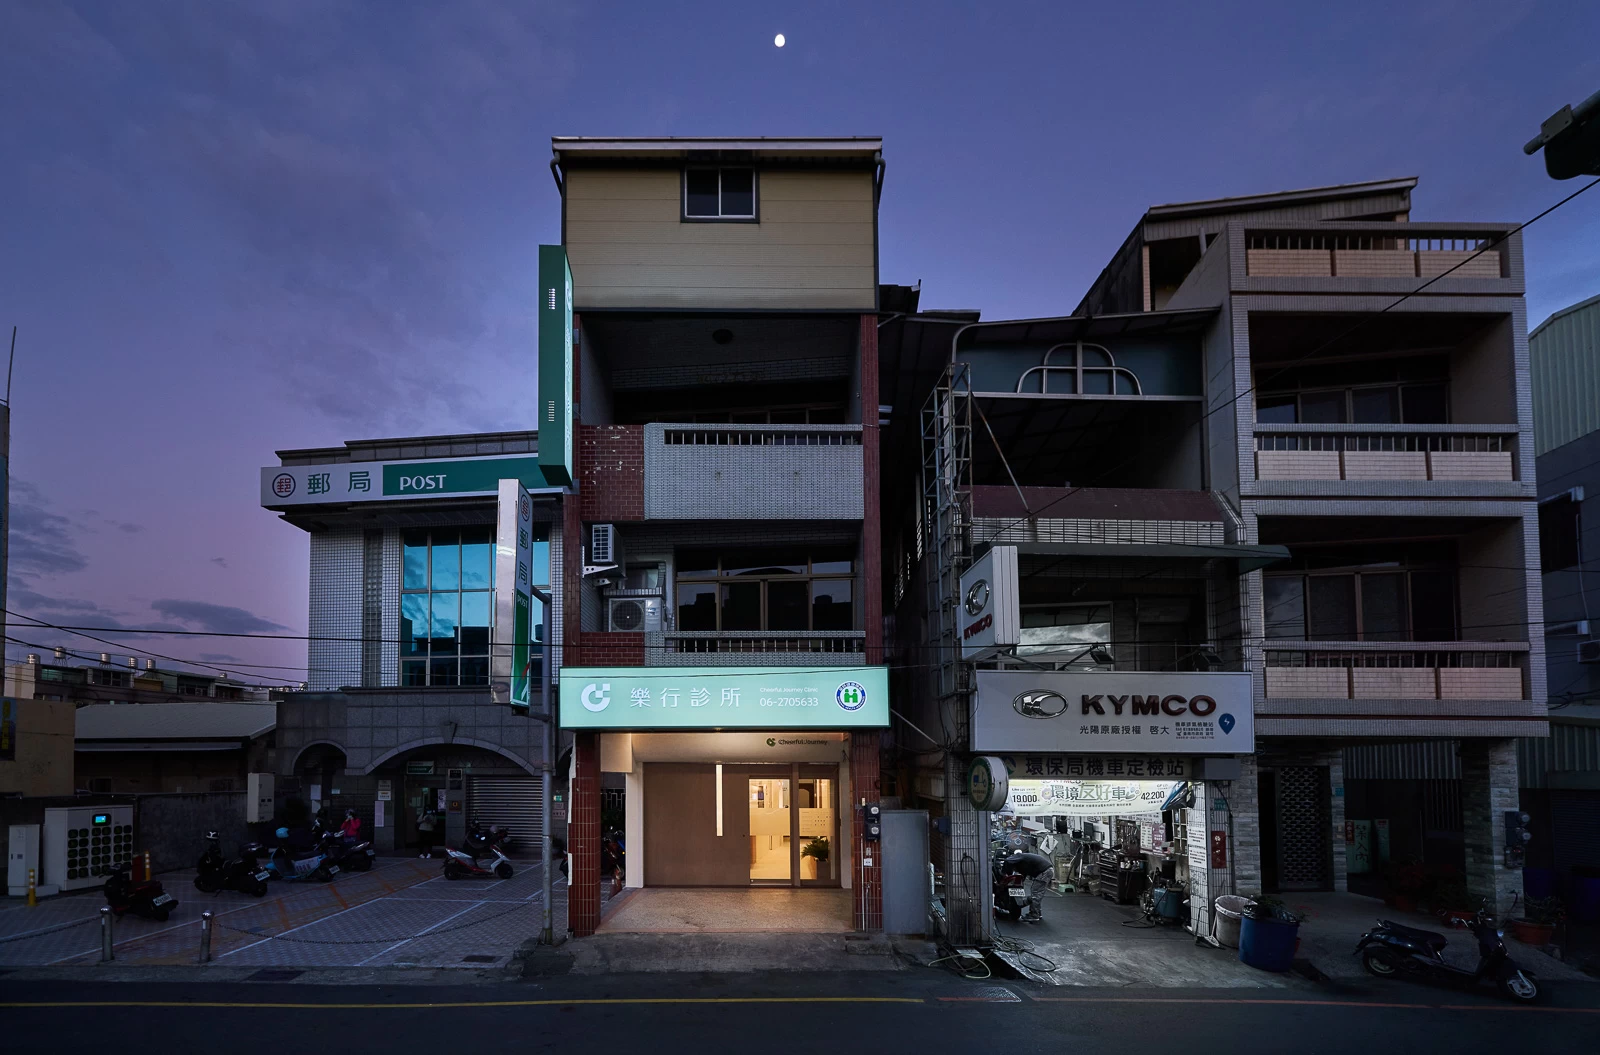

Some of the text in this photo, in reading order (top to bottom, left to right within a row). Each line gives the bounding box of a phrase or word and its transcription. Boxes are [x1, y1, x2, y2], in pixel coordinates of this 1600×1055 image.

[307, 470, 371, 495] 郵局
[399, 474, 447, 491] POST
[516, 593, 529, 608] POST
[963, 613, 993, 641] KYMCO
[629, 687, 741, 708] 樂行診所
[759, 697, 820, 707] 06-2705633
[1081, 694, 1217, 717] KYMCO
[1079, 725, 1142, 735] 光陽原廠授權
[804, 738, 828, 746] Journey
[1025, 757, 1184, 777] 環保局機車定檢站
[1051, 783, 1127, 801] 環境友好車
